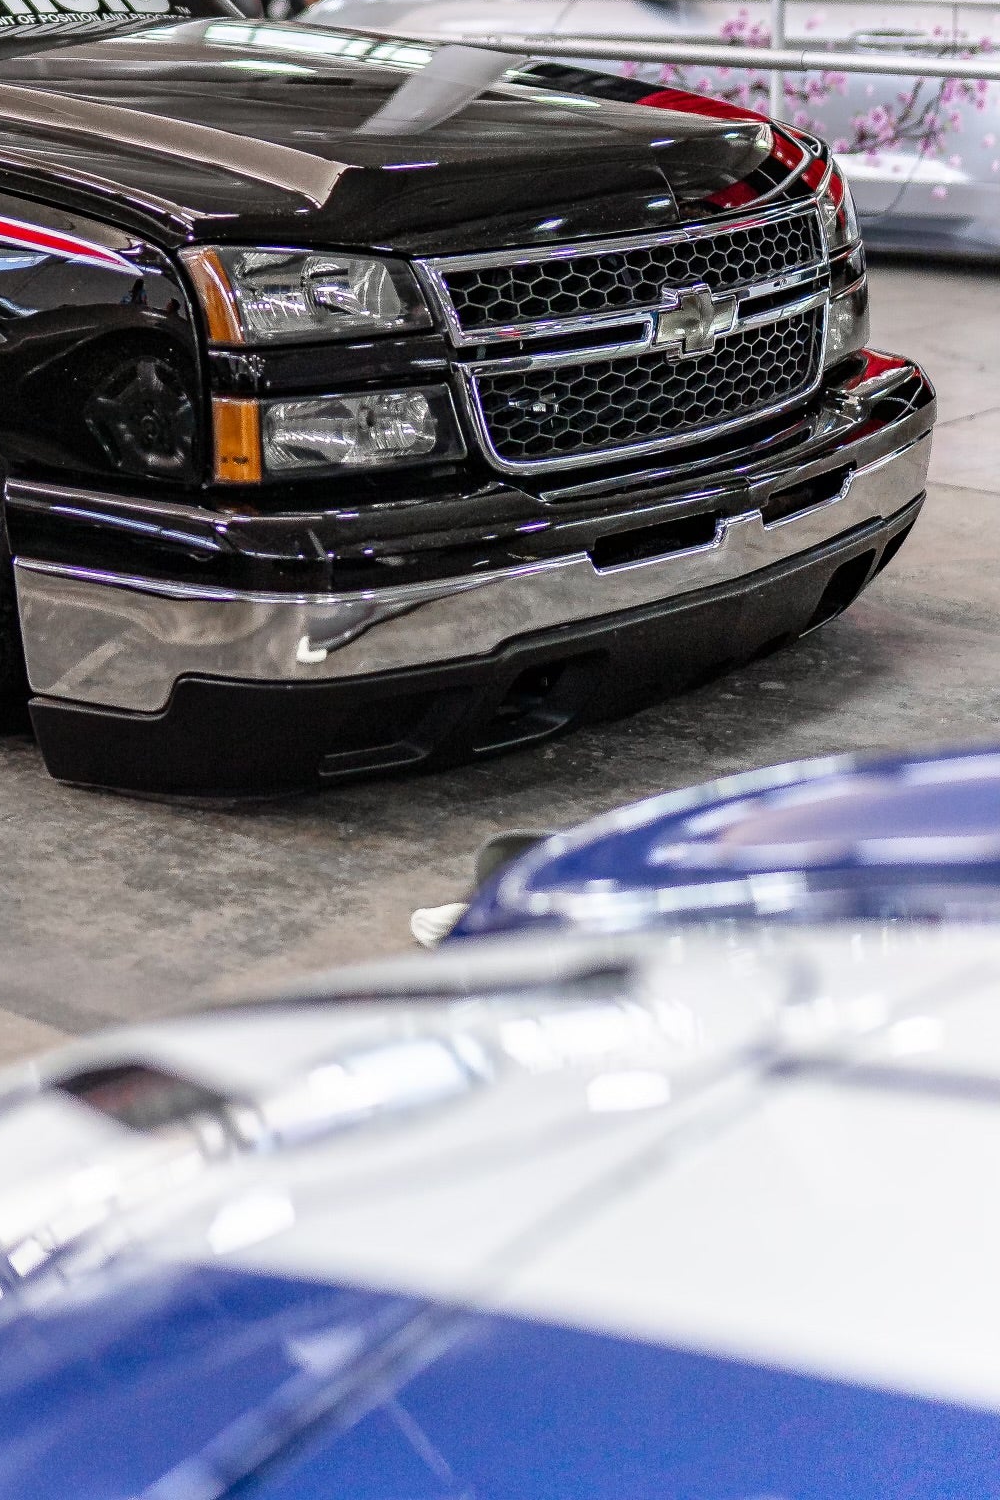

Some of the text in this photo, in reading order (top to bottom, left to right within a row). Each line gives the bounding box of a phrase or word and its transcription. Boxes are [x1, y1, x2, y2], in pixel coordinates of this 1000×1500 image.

[17, 14, 38, 25] OF
[38, 12, 101, 24] POSITION
[101, 12, 129, 21] AND
